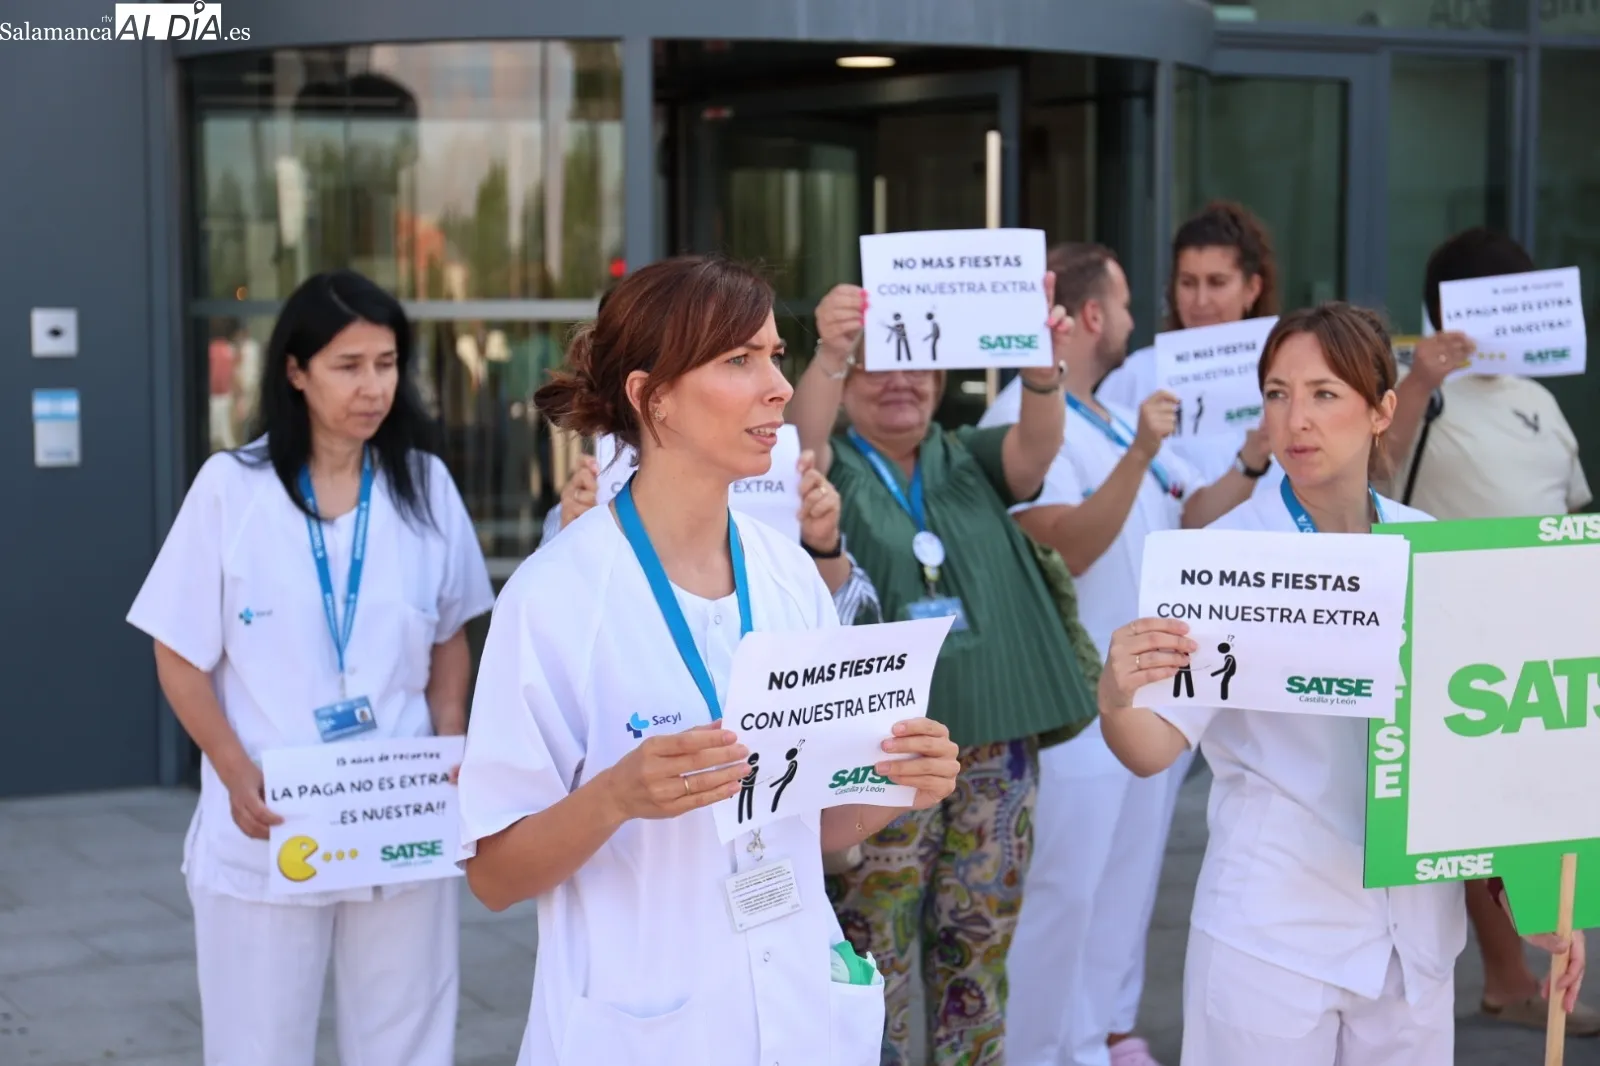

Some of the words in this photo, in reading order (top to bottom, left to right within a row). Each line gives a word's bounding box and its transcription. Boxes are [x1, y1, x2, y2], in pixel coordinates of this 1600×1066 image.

[893, 257, 917, 270] NO
[922, 256, 954, 269] MAS
[960, 255, 1022, 268] FIESTAS
[878, 283, 911, 296] CON
[916, 281, 988, 295] NUESTRA
[992, 281, 1037, 294] EXTRA
[978, 335, 1039, 350] SATSE
[733, 480, 785, 494] EXTRA
[1181, 569, 1213, 586] NO
[1219, 570, 1266, 588] MAS
[1271, 572, 1361, 592] FIESTAS
[1157, 603, 1202, 619] CON
[1208, 604, 1307, 624] NUESTRA
[1313, 609, 1380, 627] EXTRA
[768, 670, 799, 691] NO
[802, 663, 836, 688] MAS
[839, 653, 908, 680] FIESTAS
[1285, 675, 1375, 698] SATSE
[1444, 656, 1600, 738] SAT
[741, 710, 784, 731] CON
[788, 697, 865, 727] NUESTRA
[868, 688, 916, 713] EXTRA
[1299, 695, 1328, 704] Castilla
[1336, 697, 1357, 706] León
[652, 711, 682, 726] Sacyl
[271, 787, 293, 802] LA
[297, 781, 346, 799] PAGA
[350, 779, 374, 794] NO
[378, 776, 395, 791] ES
[399, 772, 450, 789] EXTRA
[865, 785, 886, 794] León
[380, 839, 444, 862] SATSE
[1415, 853, 1494, 882] SATSE
